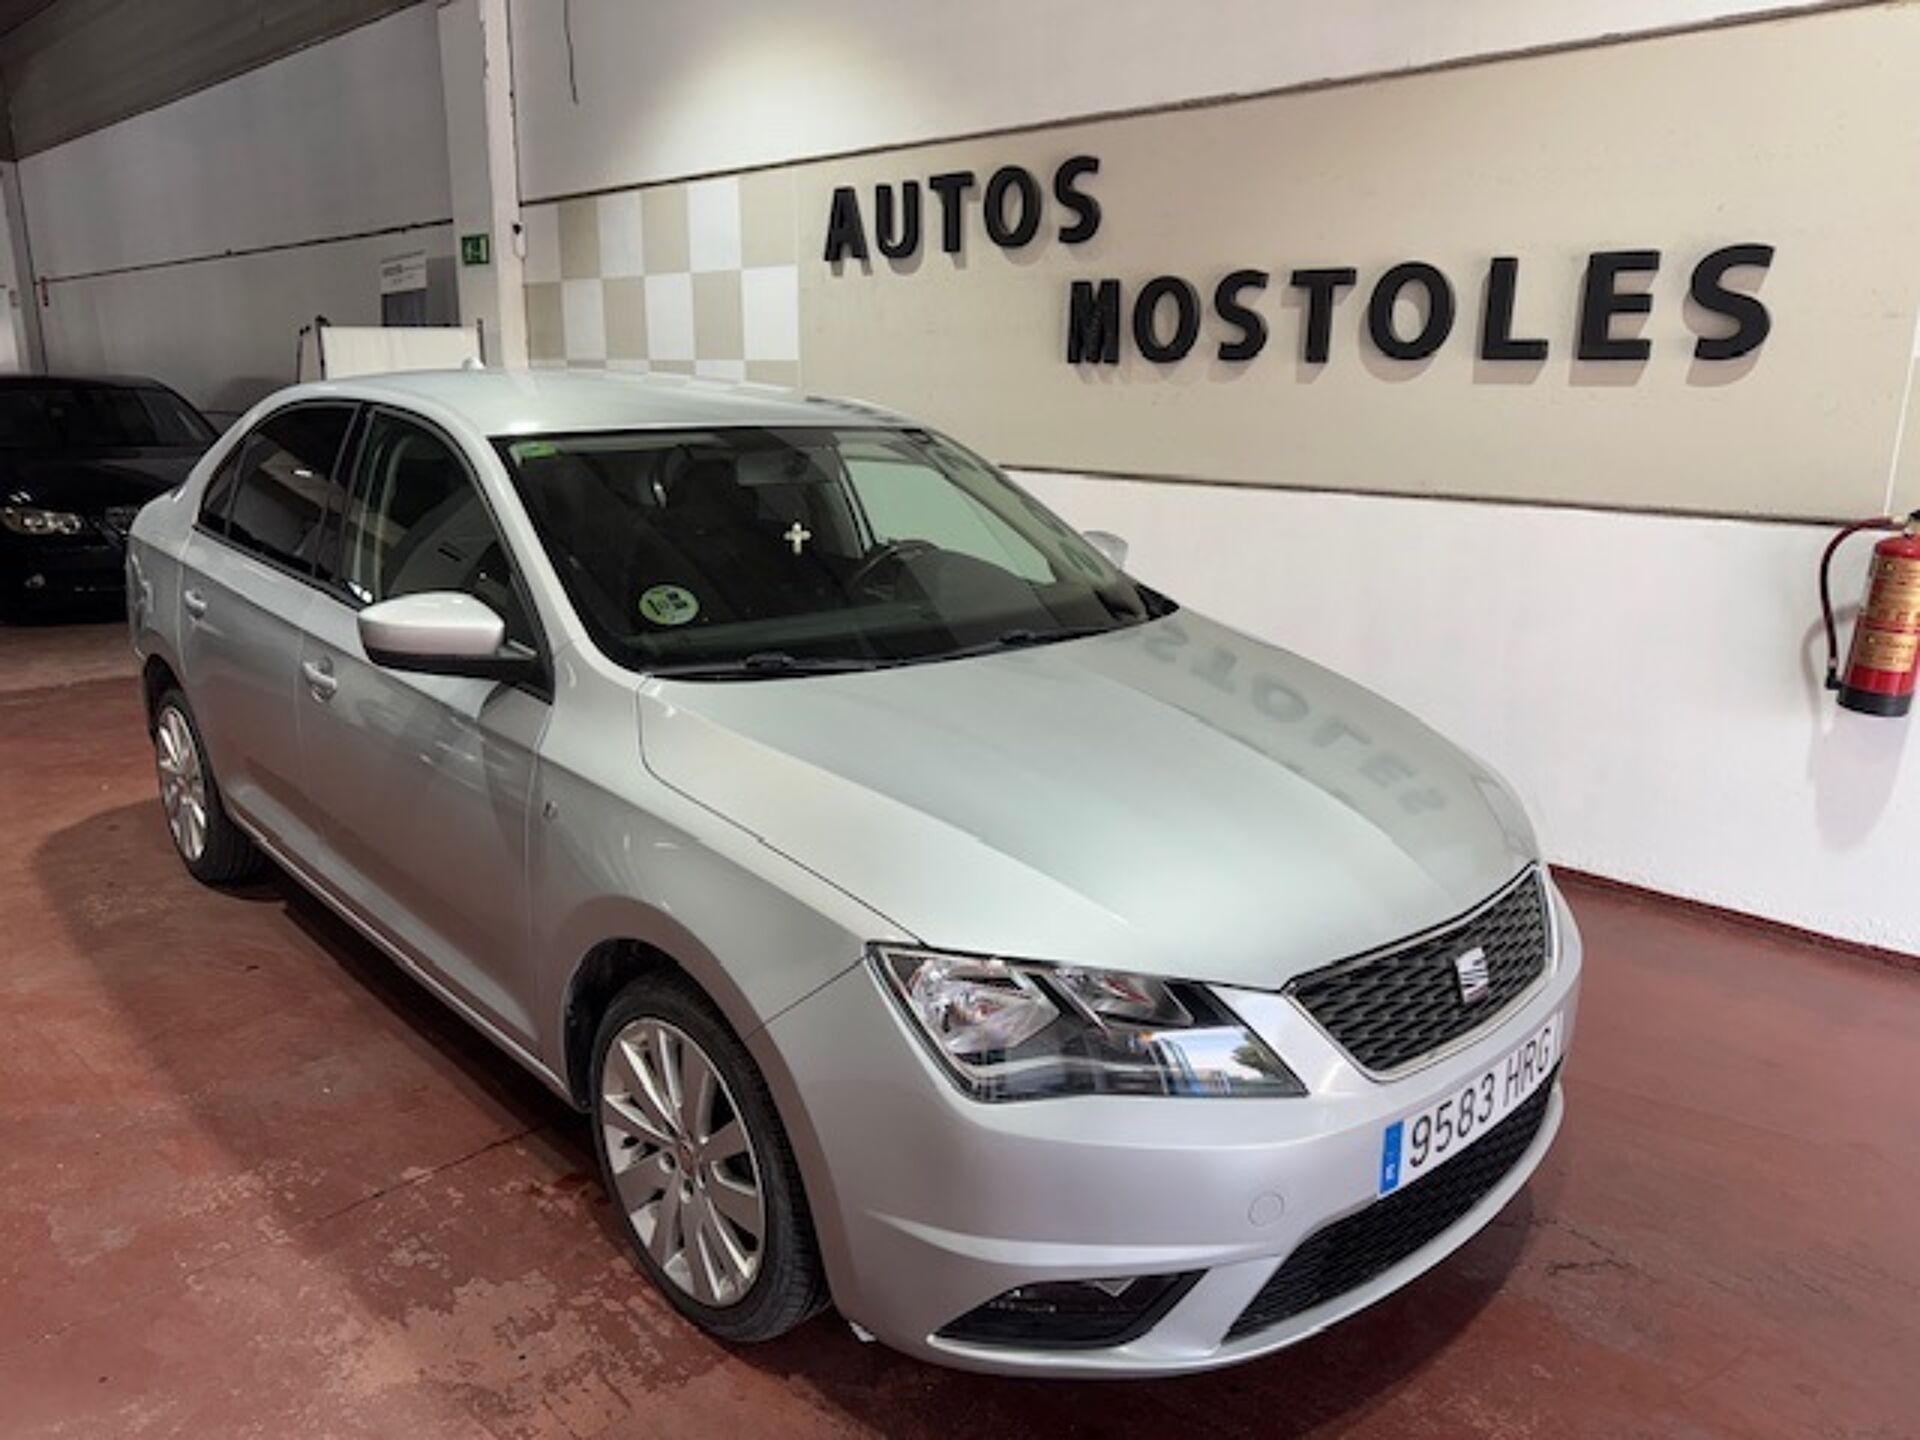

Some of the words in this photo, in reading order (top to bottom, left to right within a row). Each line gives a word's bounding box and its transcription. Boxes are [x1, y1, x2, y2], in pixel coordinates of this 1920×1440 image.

[824, 155, 1102, 263] AUTOS
[1066, 243, 1774, 366] MOSTOLES
[1409, 1073, 1495, 1168] 9583
[1503, 1027, 1551, 1107] HRG
